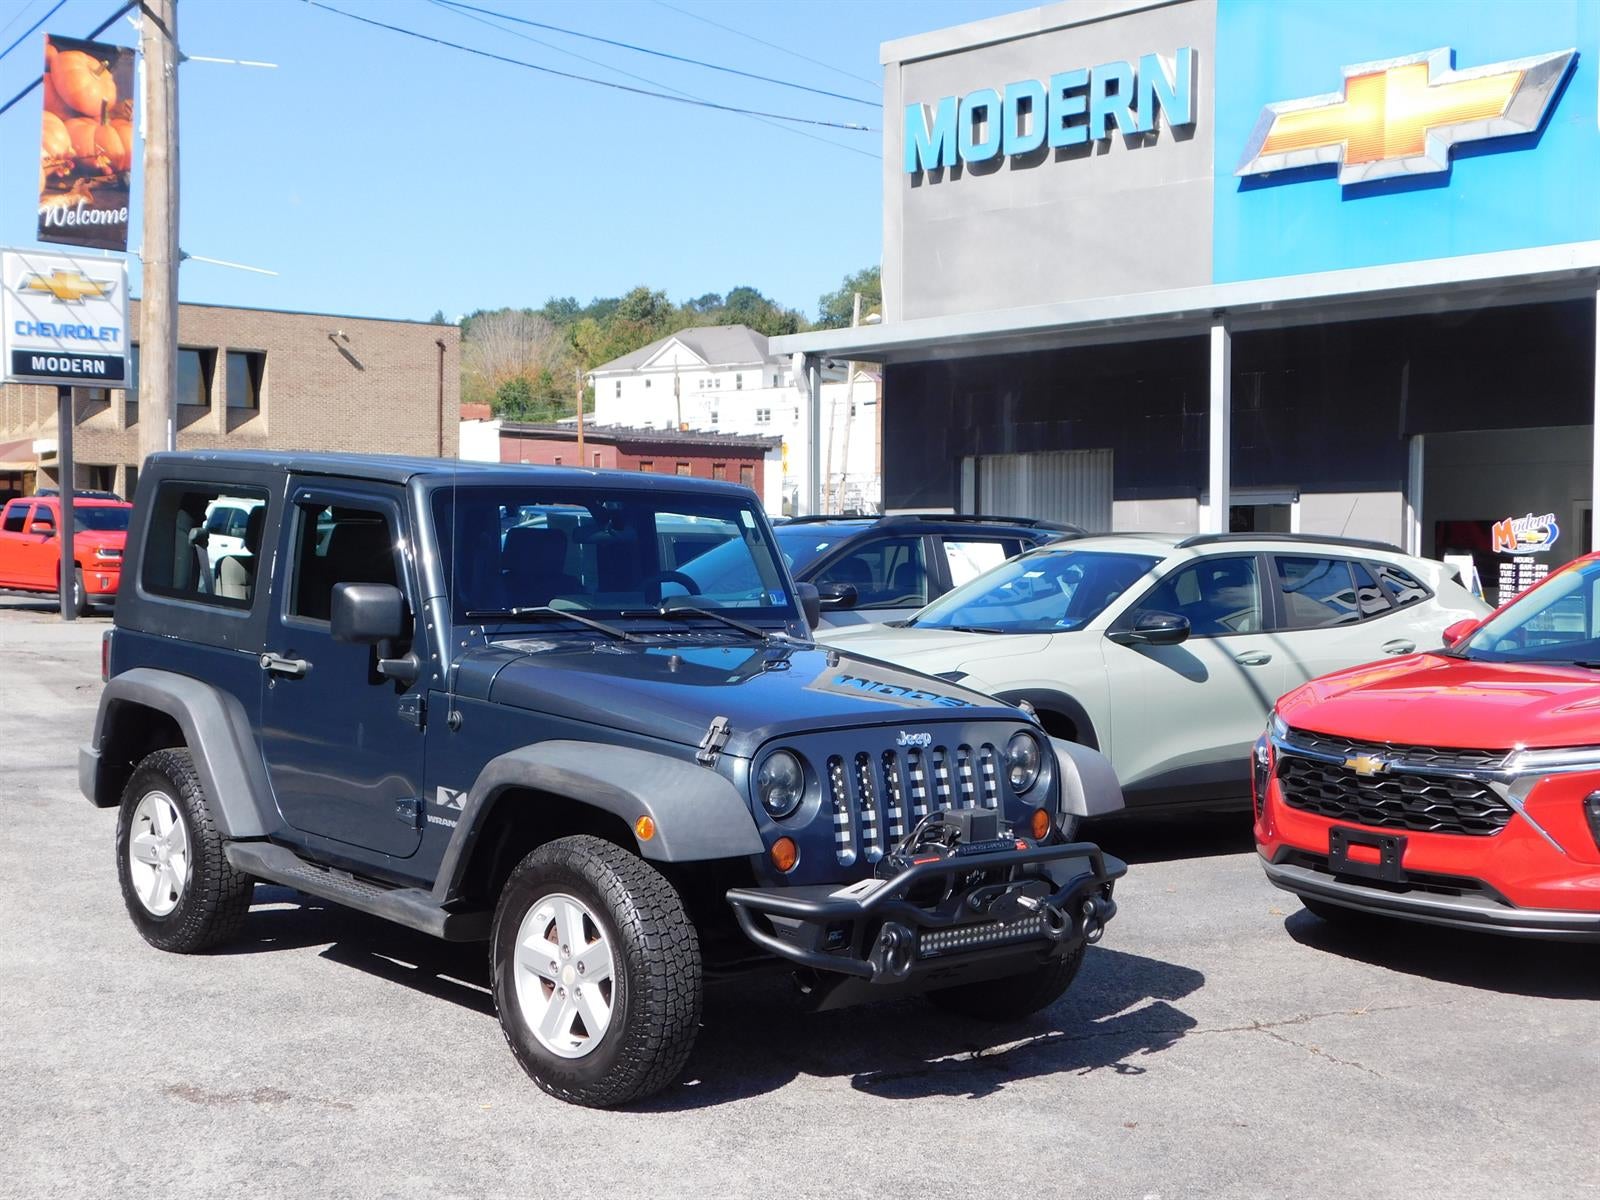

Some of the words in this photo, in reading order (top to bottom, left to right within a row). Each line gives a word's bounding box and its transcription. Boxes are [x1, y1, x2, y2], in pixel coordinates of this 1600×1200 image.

[904, 46, 1194, 175] MODERN
[38, 201, 128, 227] Welcome
[14, 320, 121, 342] CHEVROLET
[31, 356, 105, 374] MODERN
[1492, 513, 1556, 553] Modern
[896, 730, 932, 748] Jeep
[426, 814, 458, 828] WRAN
